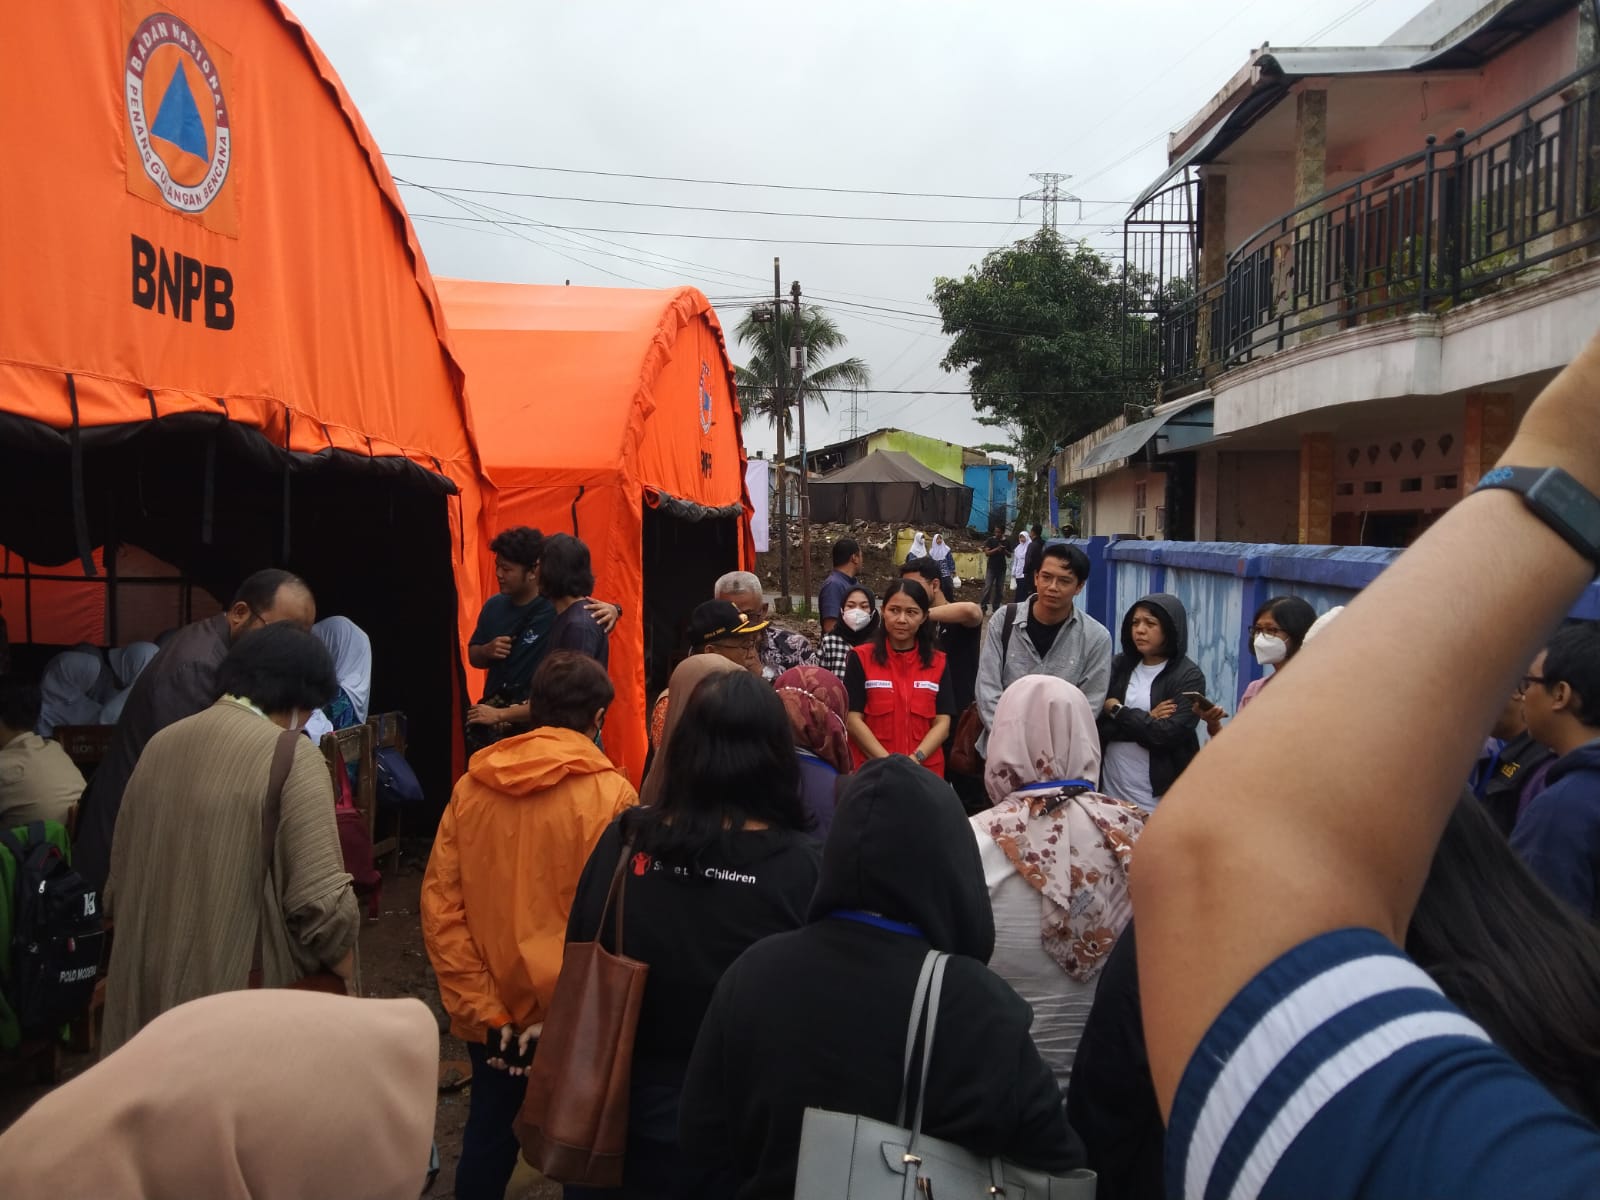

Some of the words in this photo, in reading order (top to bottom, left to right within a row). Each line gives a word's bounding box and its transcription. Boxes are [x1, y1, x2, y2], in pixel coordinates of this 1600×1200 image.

[130, 22, 168, 72] BADAN
[172, 23, 224, 120] NASIONAL
[204, 136, 227, 199] BENCANA
[131, 232, 235, 331] BNPB
[705, 867, 756, 884] Children
